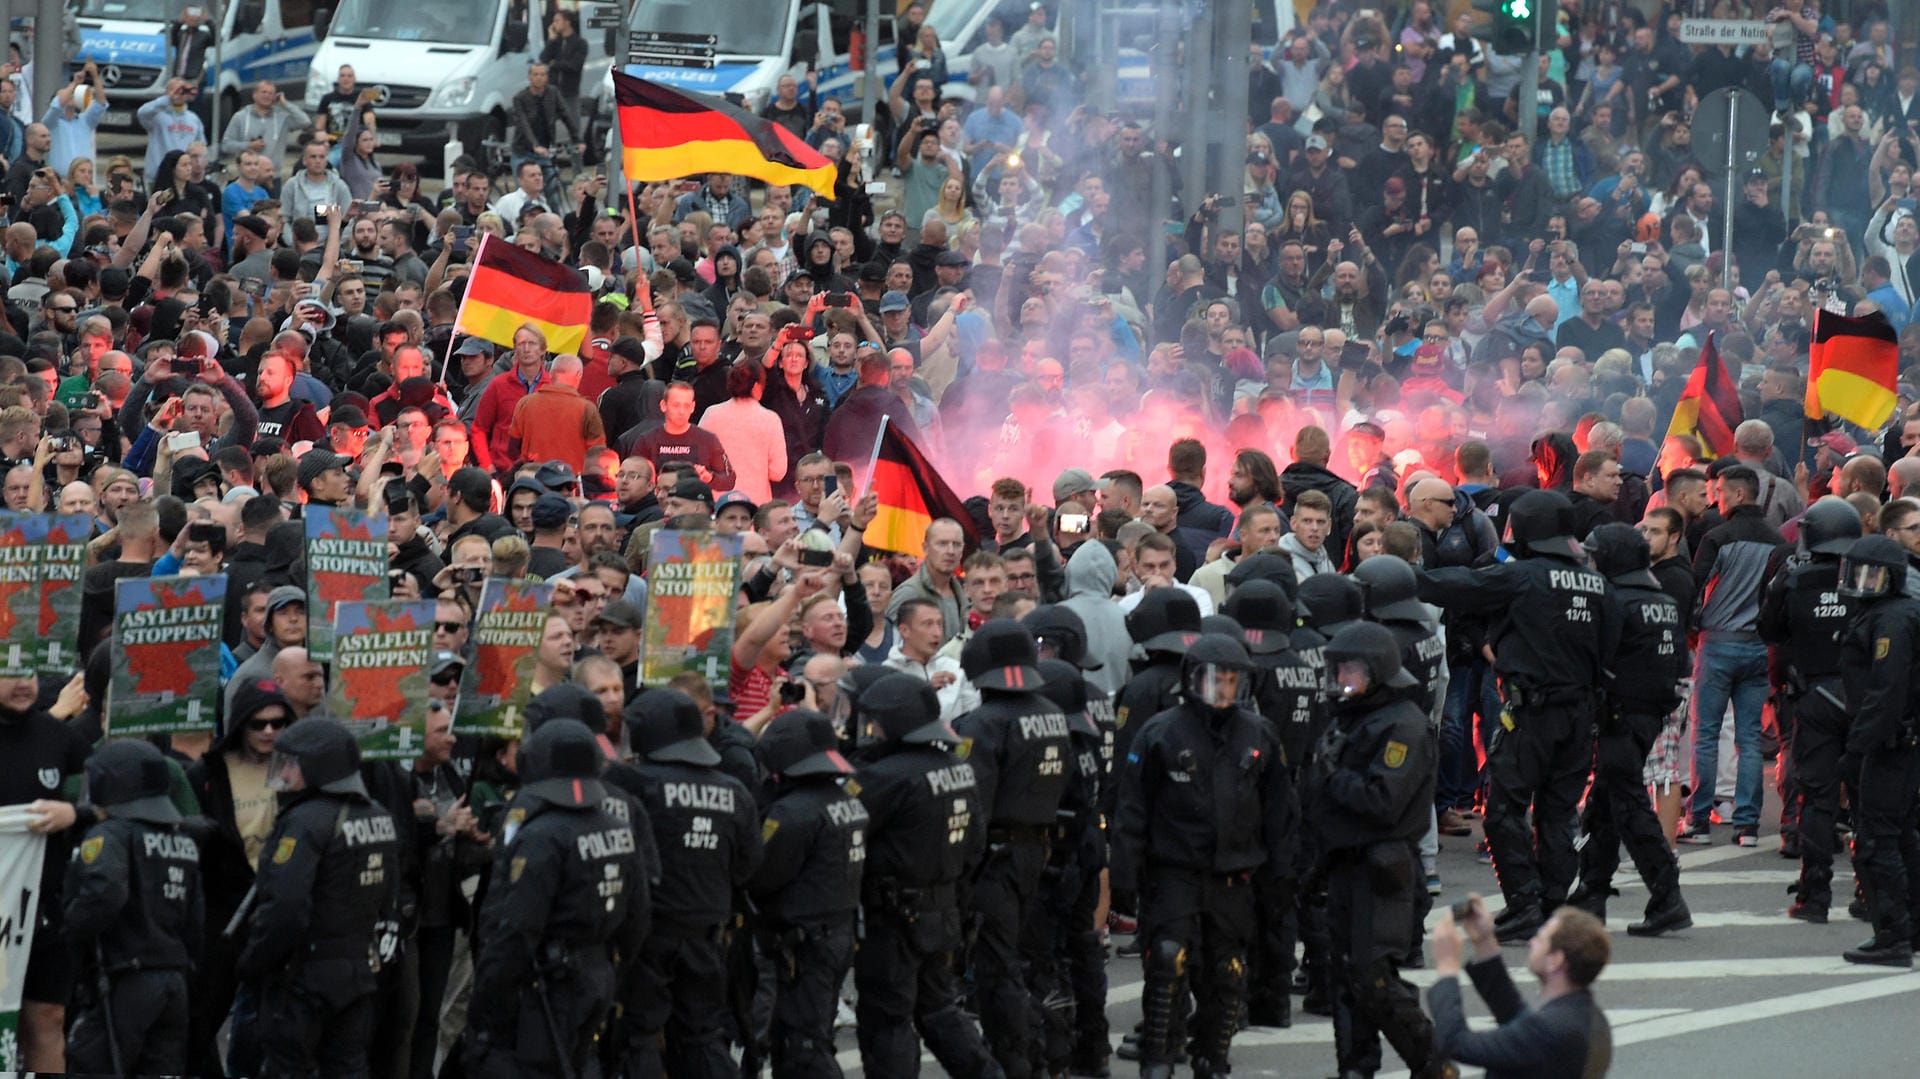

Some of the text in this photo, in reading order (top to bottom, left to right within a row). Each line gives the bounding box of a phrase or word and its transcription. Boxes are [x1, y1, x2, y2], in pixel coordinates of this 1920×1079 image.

[1685, 24, 1716, 37] Straße
[1721, 25, 1736, 38] der
[82, 38, 157, 53] POLIZEI
[643, 70, 717, 83] POLIZEI
[308, 538, 384, 558] ASYLFLUT
[311, 555, 384, 577] STOPPEN!
[653, 562, 738, 579] ASYLFLUT
[654, 580, 734, 597] STOPPEN!
[1549, 570, 1605, 595] POLIZEI
[1572, 596, 1588, 609] SN
[1820, 591, 1839, 604] SN
[121, 604, 222, 629] ASYLFLUT
[479, 611, 547, 628] ASYLFLUT
[1812, 604, 1847, 618] 12/20
[122, 623, 218, 645] STOPPEN!
[338, 629, 431, 651] ASYLFLUT
[478, 628, 542, 648] STOPPEN!
[339, 649, 428, 669] STOPPEN!
[663, 782, 736, 813] POLIZEI
[342, 815, 397, 847] POLIZEI
[692, 816, 713, 832] SN
[577, 827, 635, 861] POLIZEI
[683, 831, 719, 850] 13/12
